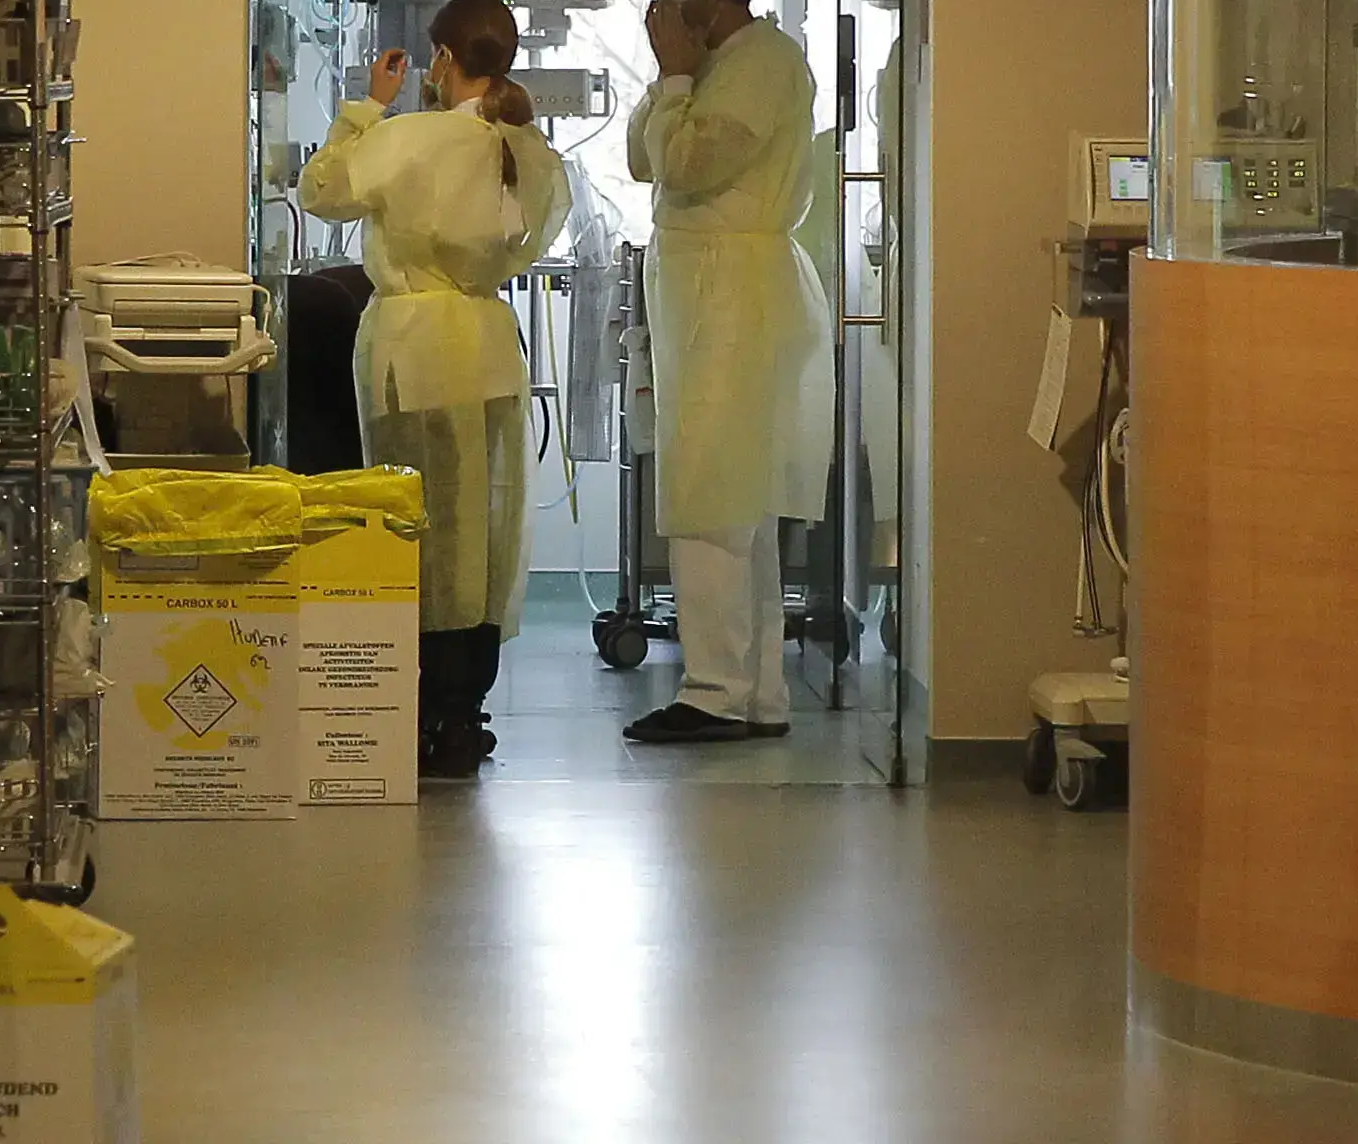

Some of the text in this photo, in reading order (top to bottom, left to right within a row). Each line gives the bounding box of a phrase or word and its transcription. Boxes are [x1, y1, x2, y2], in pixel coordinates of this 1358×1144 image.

[166, 598, 238, 609] CARBOX 50 L
